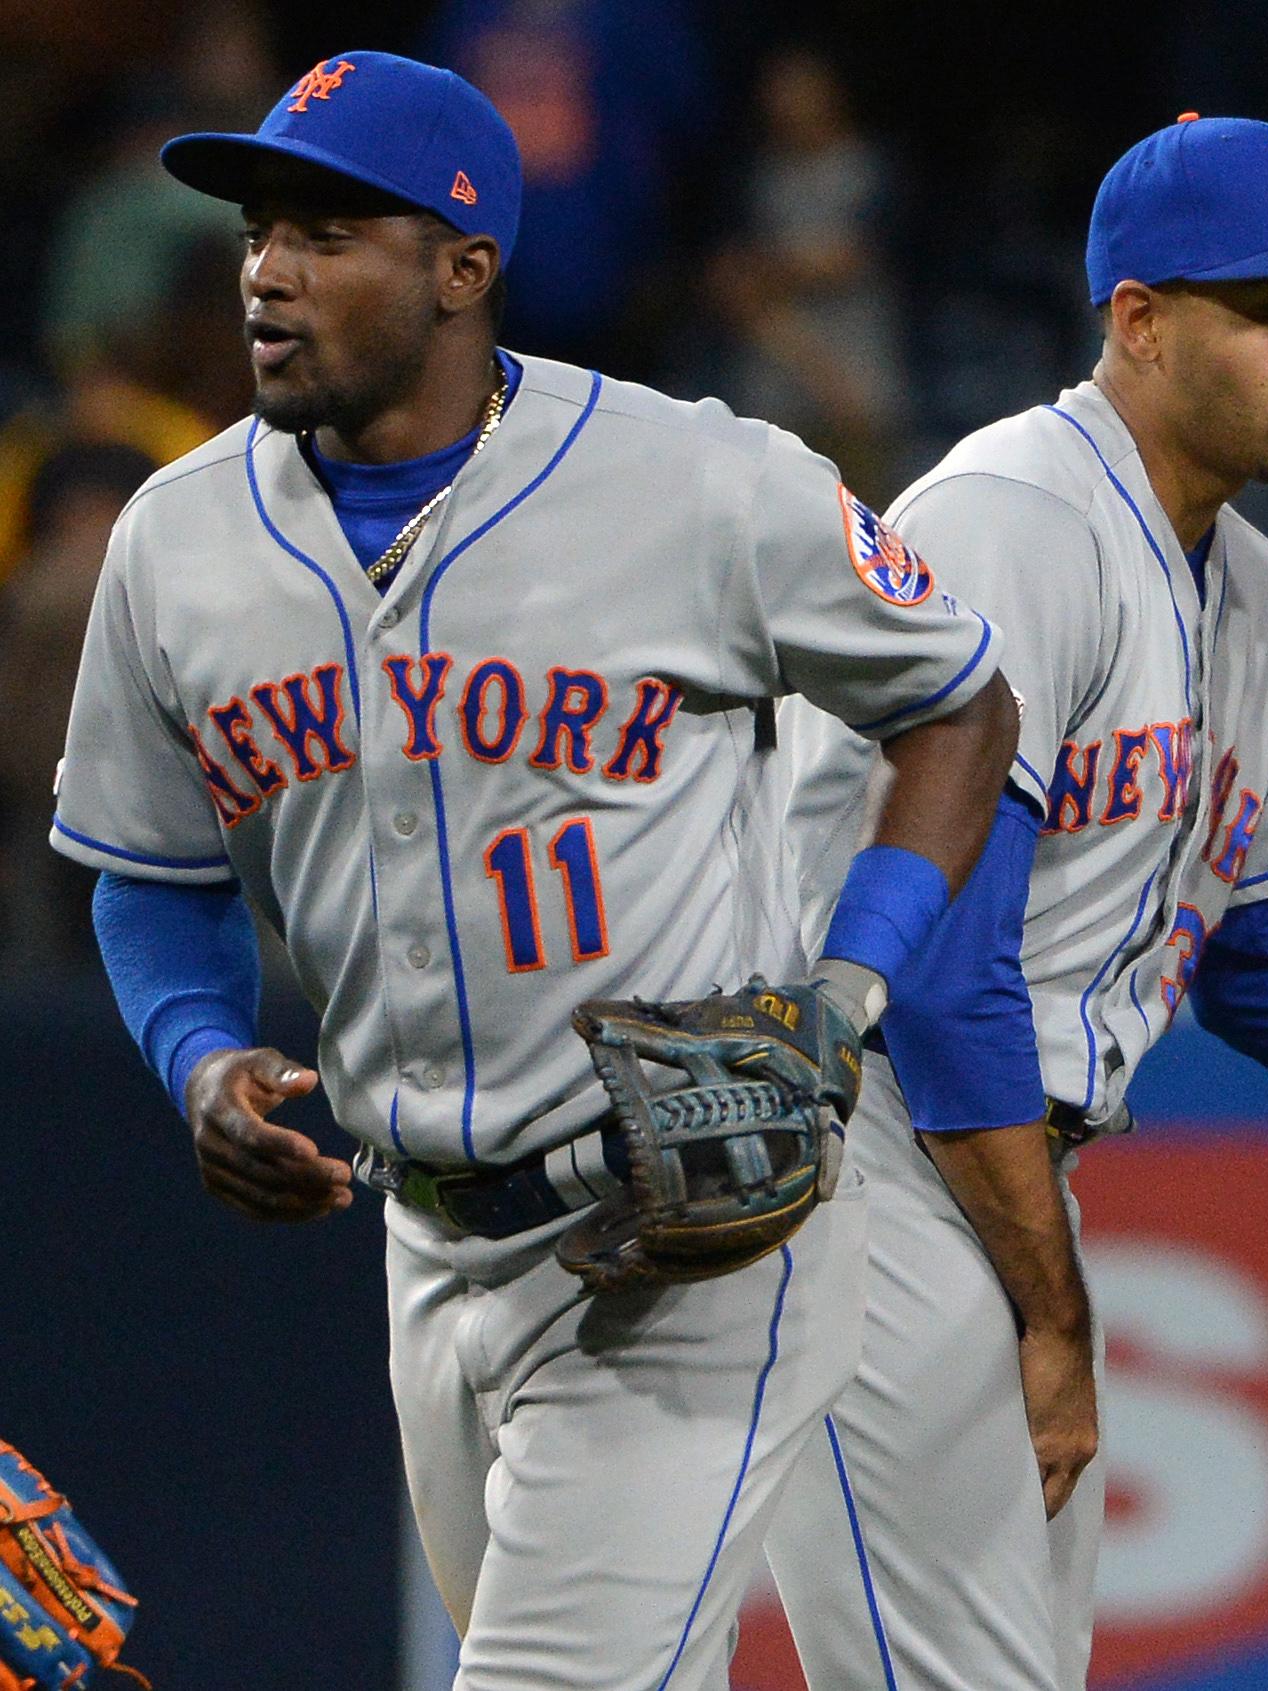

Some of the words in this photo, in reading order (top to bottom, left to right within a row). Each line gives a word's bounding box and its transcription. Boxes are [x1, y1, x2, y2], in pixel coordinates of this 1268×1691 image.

[188, 661, 357, 830] NEW
[382, 652, 684, 784] YORK
[482, 815, 612, 975] 11
